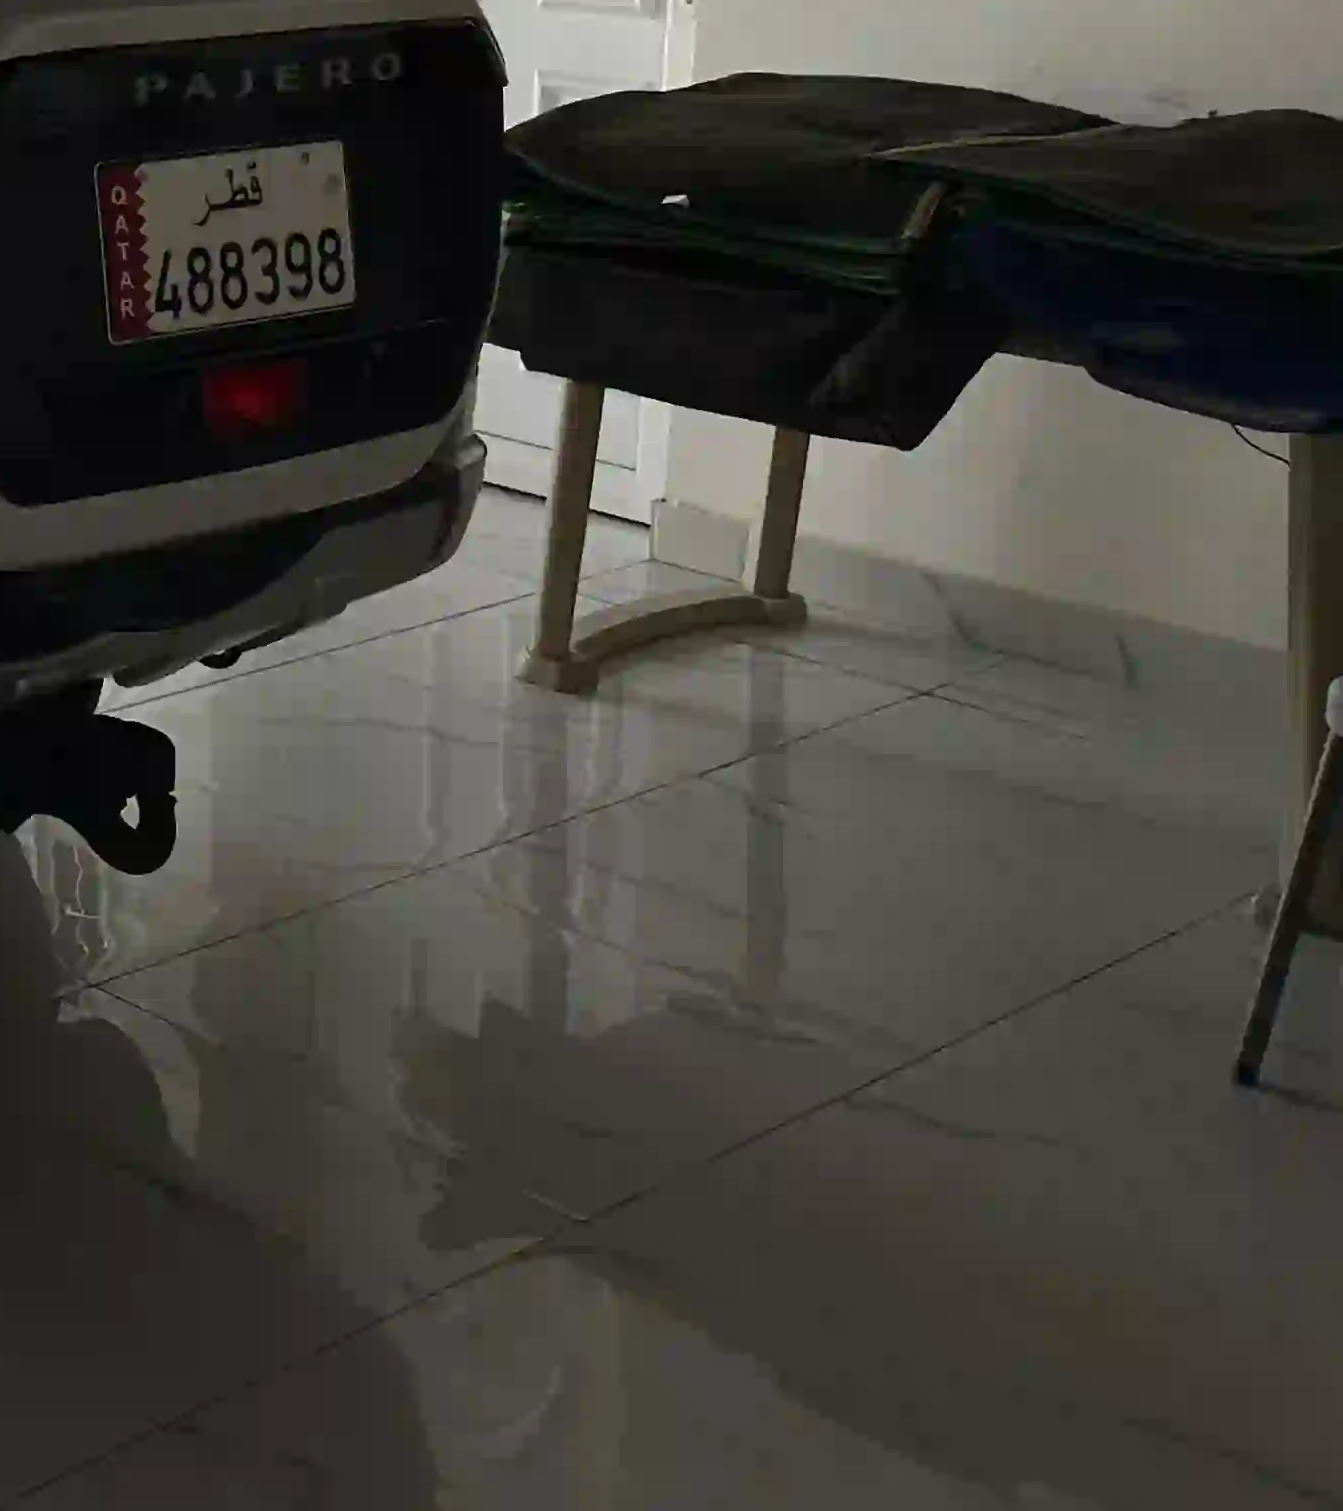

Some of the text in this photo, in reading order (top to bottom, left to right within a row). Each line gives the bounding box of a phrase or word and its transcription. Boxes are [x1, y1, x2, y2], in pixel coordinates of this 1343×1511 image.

[133, 52, 403, 106] PAJERO
[192, 161, 264, 227] قطر
[110, 185, 136, 320] QATAR
[154, 227, 347, 320] 488398
